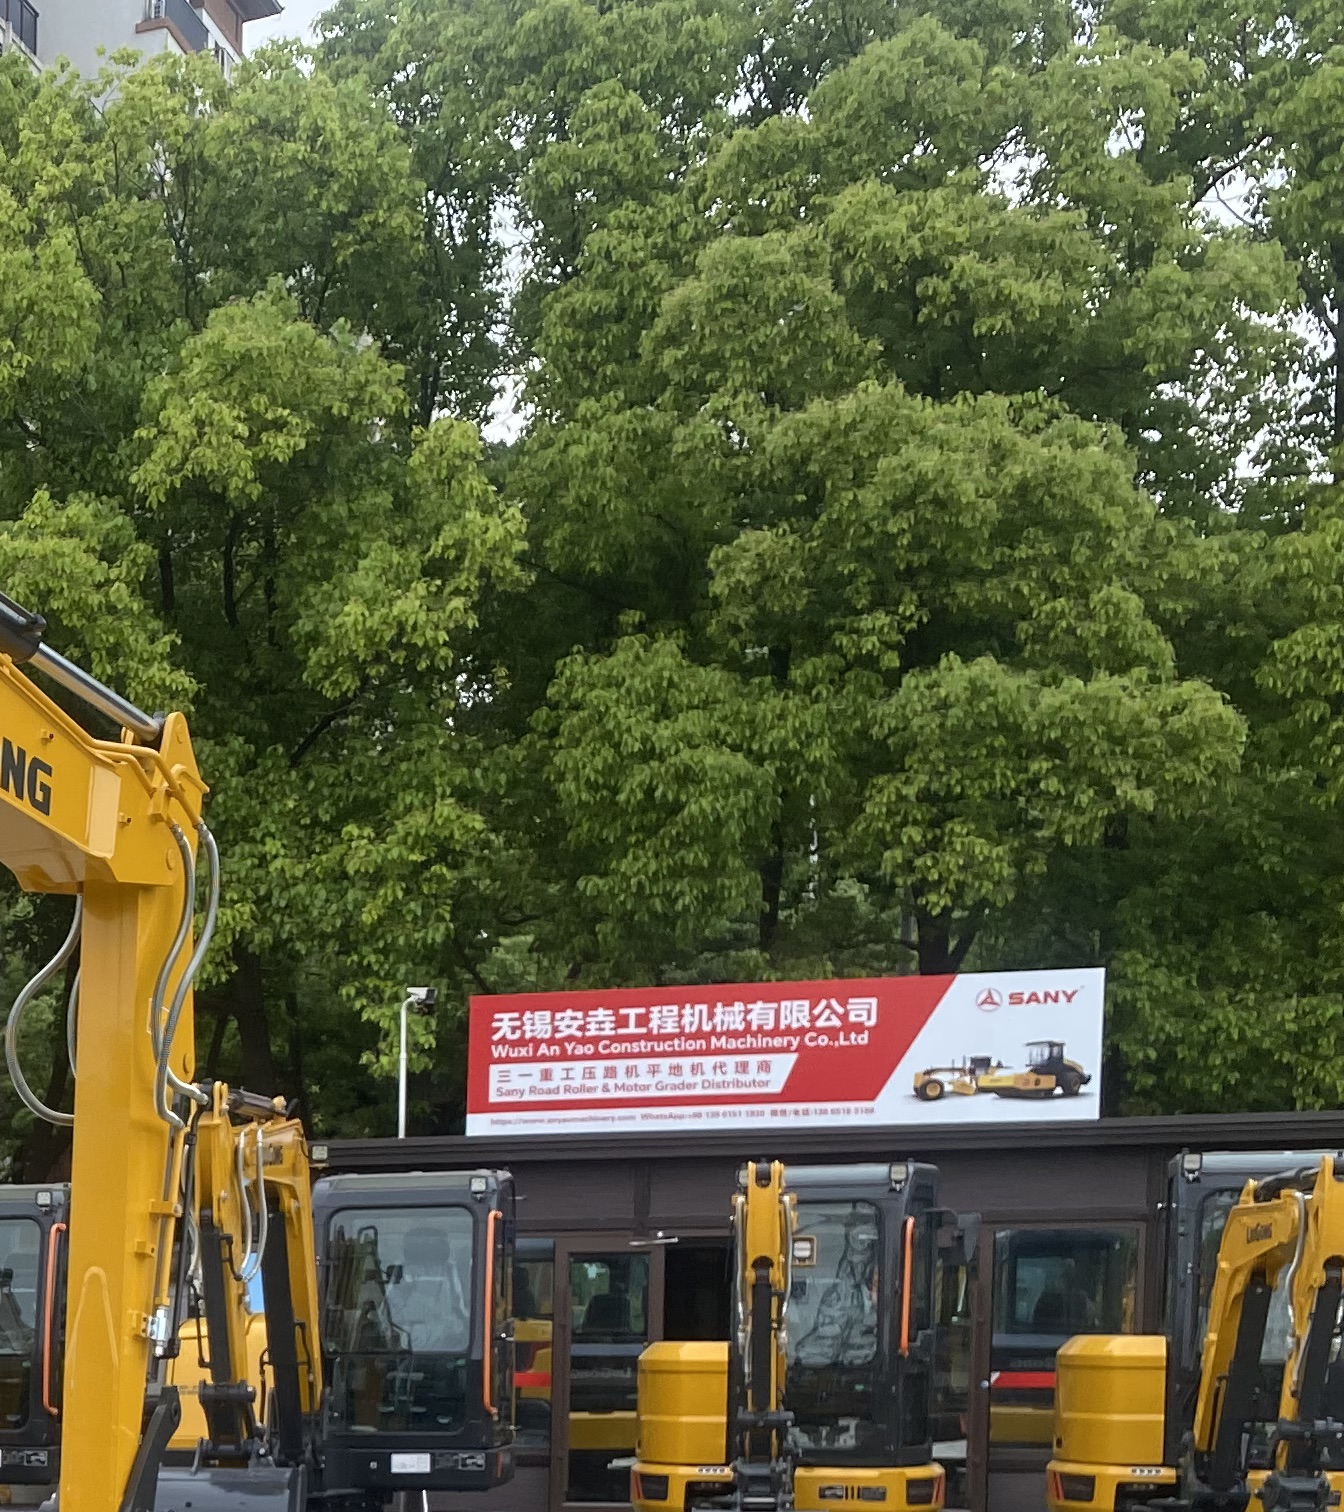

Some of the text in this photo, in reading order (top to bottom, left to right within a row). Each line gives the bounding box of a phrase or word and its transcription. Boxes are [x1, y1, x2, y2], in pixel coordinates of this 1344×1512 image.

[1008, 989, 1079, 1005] SANY
[491, 997, 879, 1042] 无锡安垚工程机械有限公司
[491, 1029, 869, 1059] Wuxi An Yao Construction Machinery Co.,Ltd
[497, 1059, 772, 1083] 三一重工压路机平地机代理商
[496, 1078, 771, 1099] Sany Road Roller & Motor Grader Distributor
